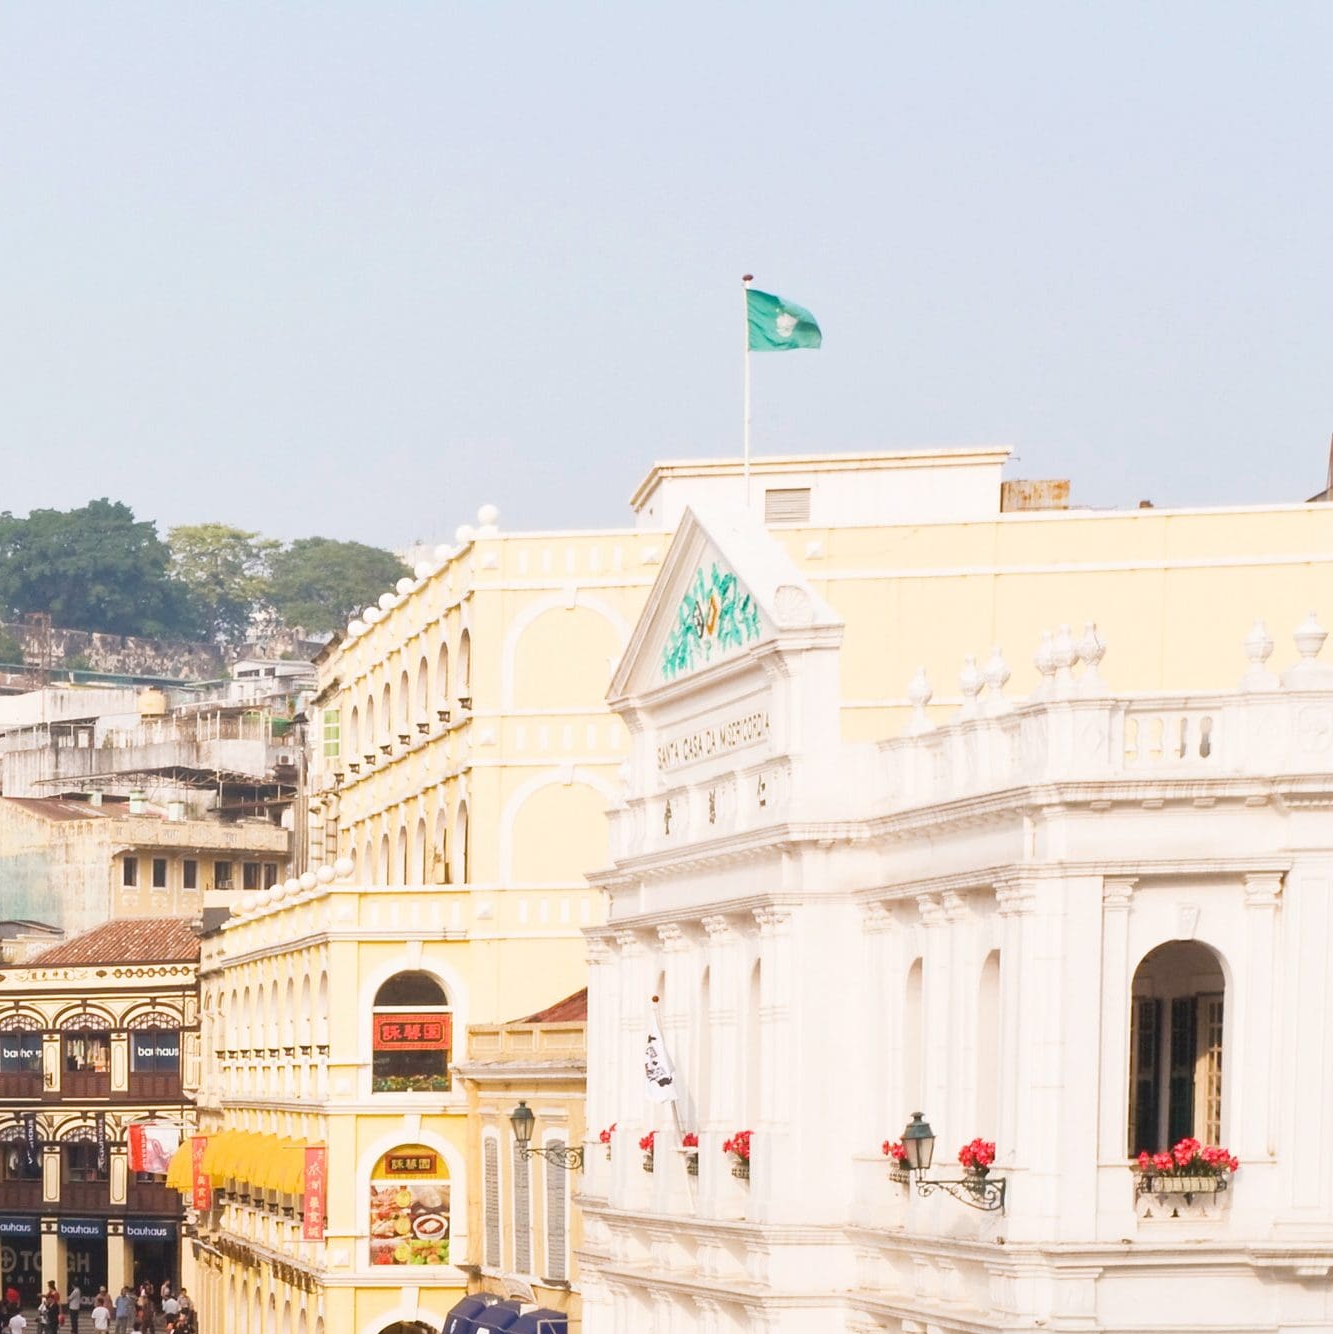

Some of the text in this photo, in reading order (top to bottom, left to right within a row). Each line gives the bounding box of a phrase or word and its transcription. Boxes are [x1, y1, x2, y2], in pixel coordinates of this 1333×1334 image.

[657, 743, 680, 770] SANTA
[683, 733, 704, 761] CASA
[706, 730, 716, 756] DA
[61, 1223, 100, 1235] bauhaus
[127, 1225, 167, 1237] bauhaus
[20, 1250, 91, 1273] TOGH
